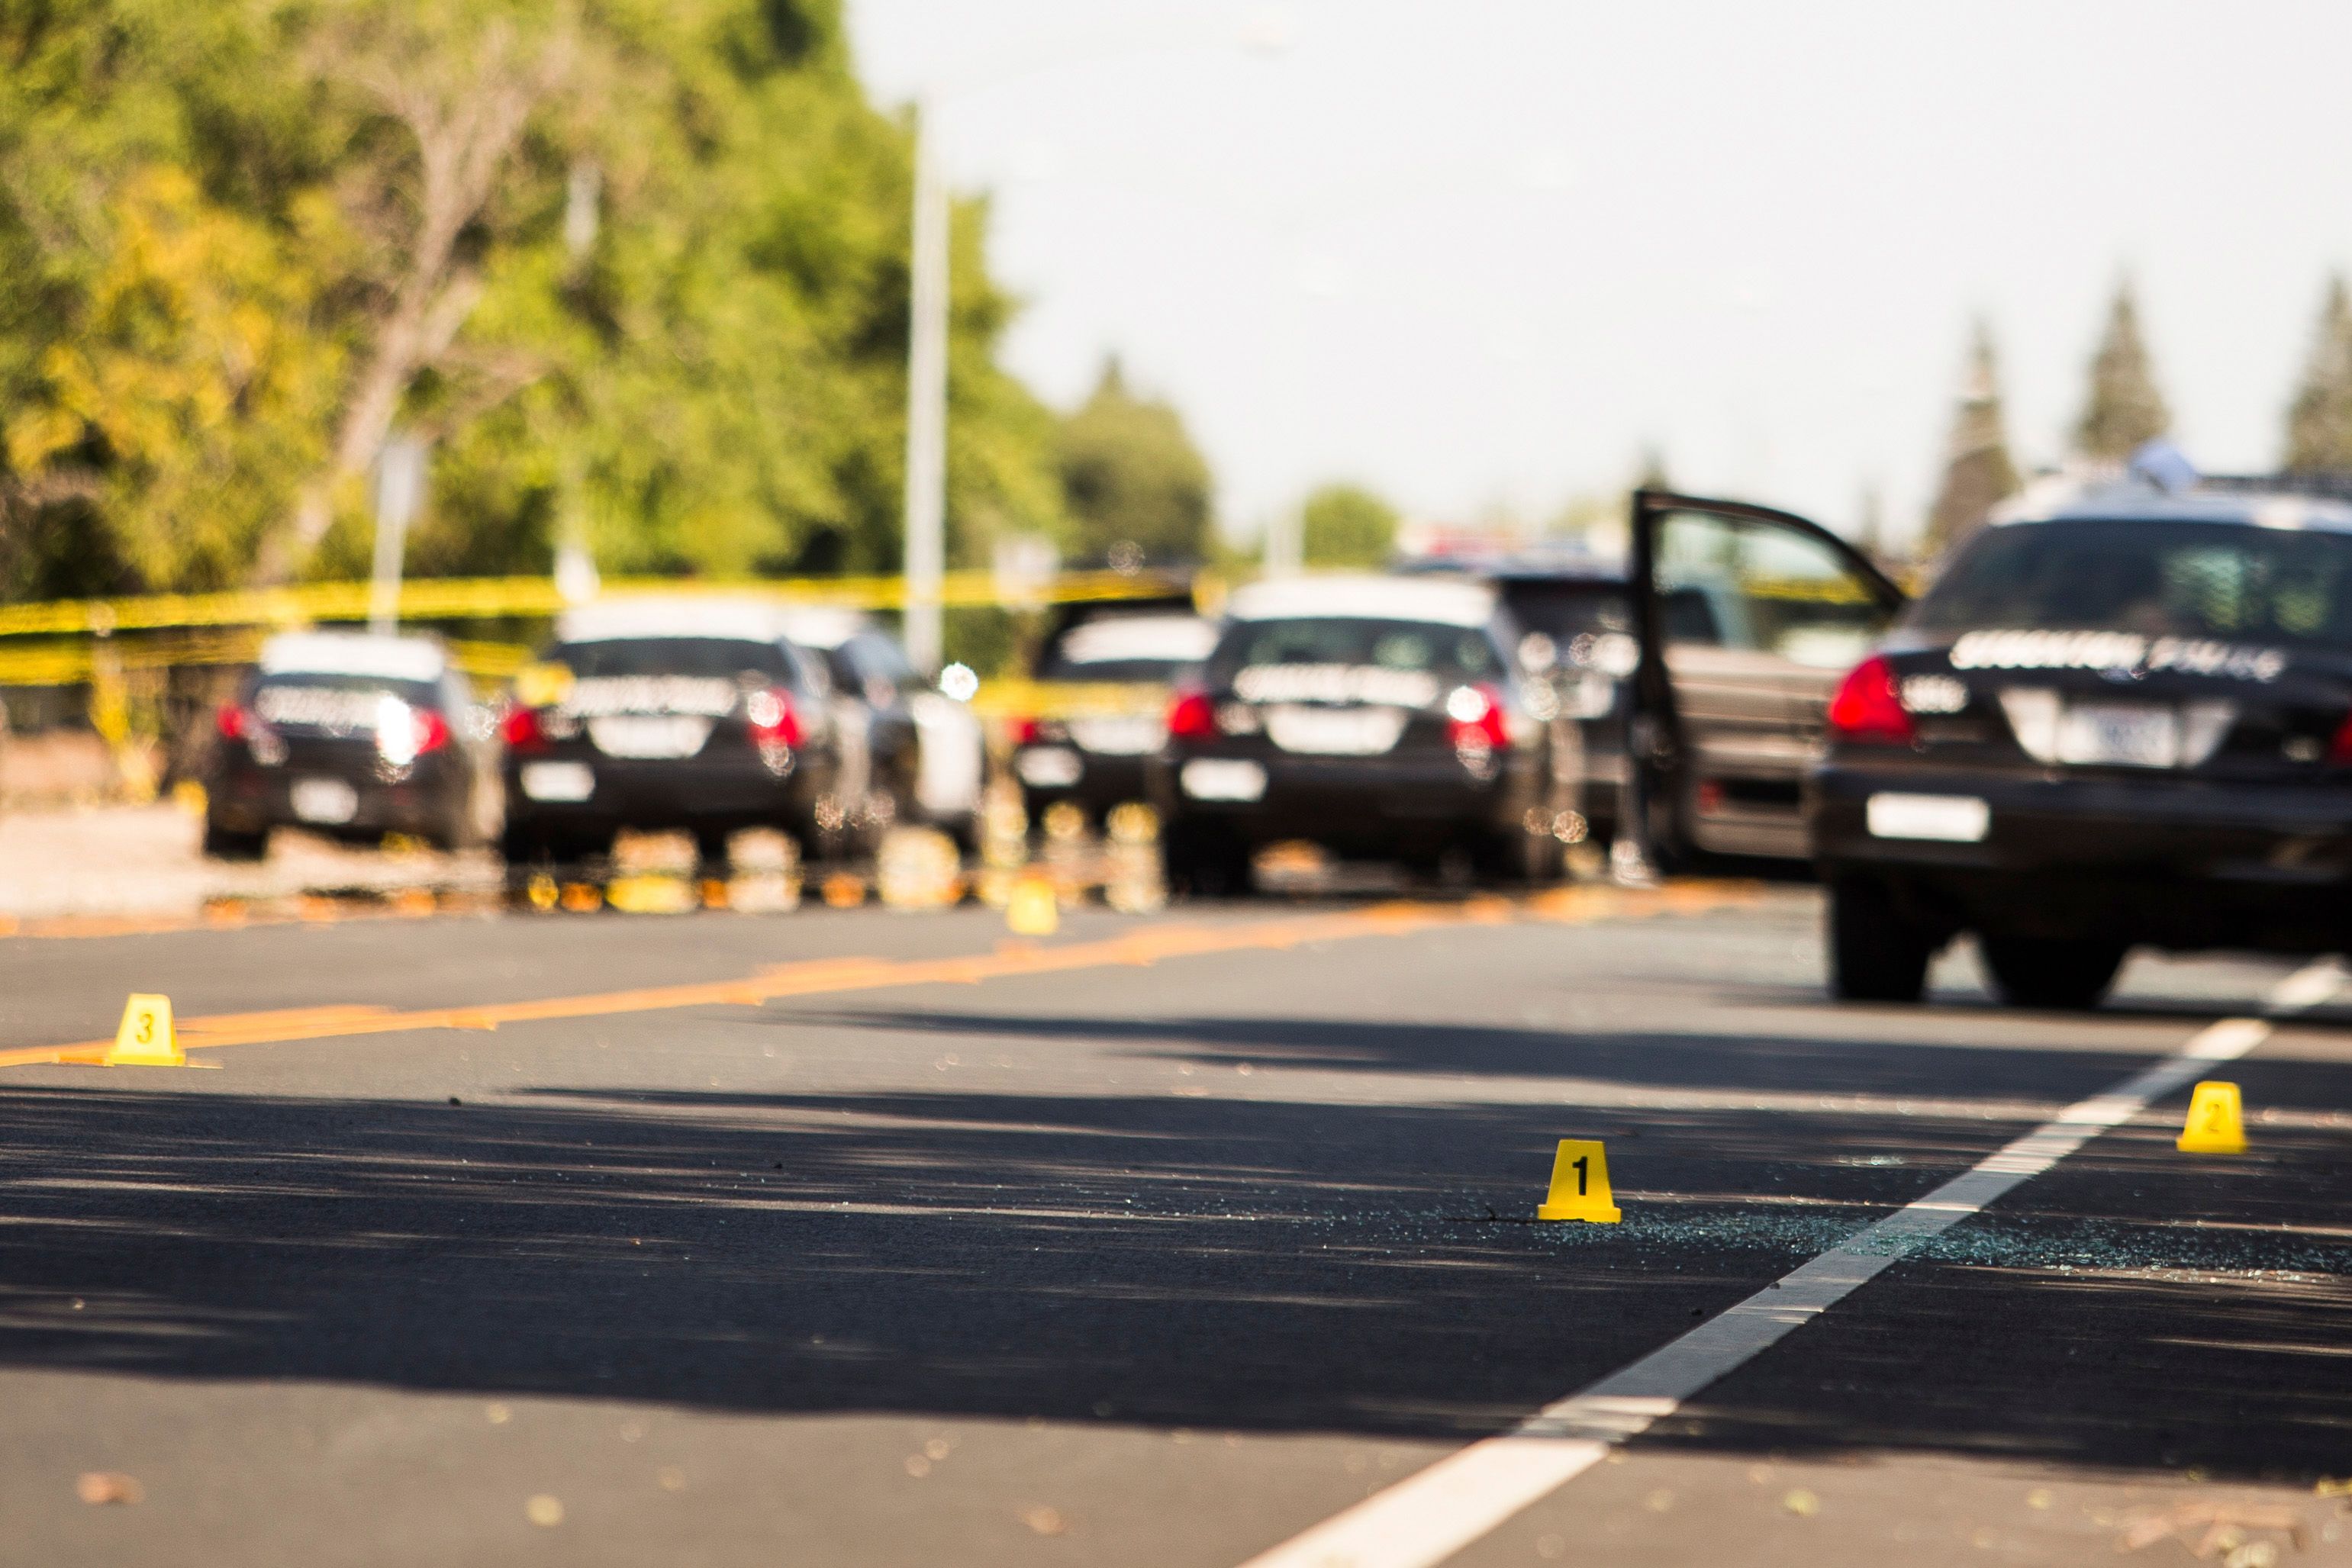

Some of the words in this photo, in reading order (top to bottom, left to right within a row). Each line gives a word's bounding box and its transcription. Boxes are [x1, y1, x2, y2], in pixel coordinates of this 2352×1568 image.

[136, 1012, 154, 1045] 3
[2205, 1103, 2222, 1134] 2
[1572, 1156, 1587, 1196] 1
